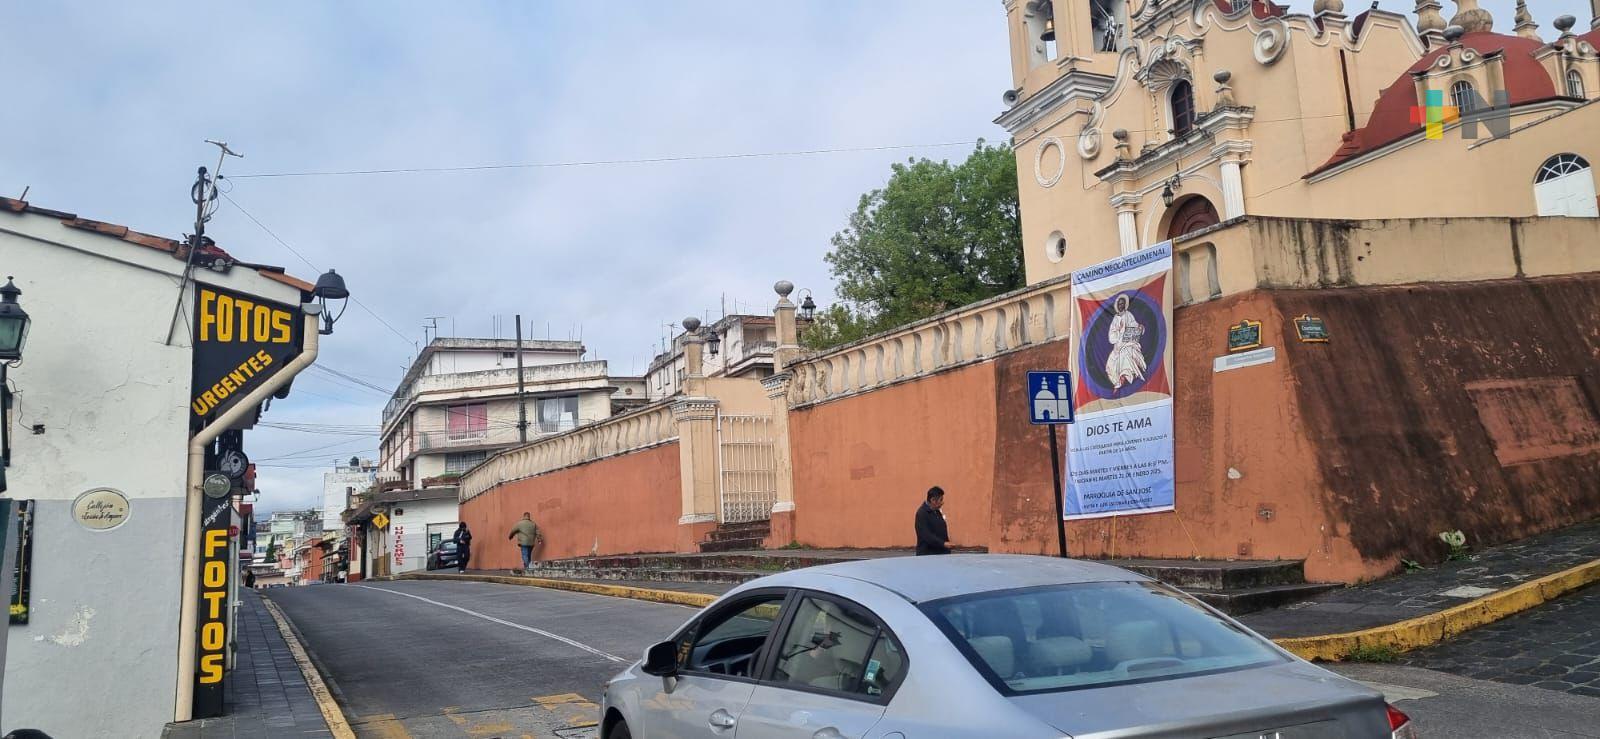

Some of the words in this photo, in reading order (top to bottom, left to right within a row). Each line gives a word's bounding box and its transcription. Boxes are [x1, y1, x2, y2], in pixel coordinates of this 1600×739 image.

[1077, 267, 1104, 281] CAMINO
[200, 289, 291, 343] FOTOS
[191, 349, 273, 416] URGENTES
[1086, 423, 1110, 437] DIOS
[1112, 421, 1123, 433] TE
[1126, 416, 1152, 431] AMA
[1116, 489, 1124, 497] DE
[1125, 488, 1138, 496] SAN
[200, 529, 229, 684] FOTOS
